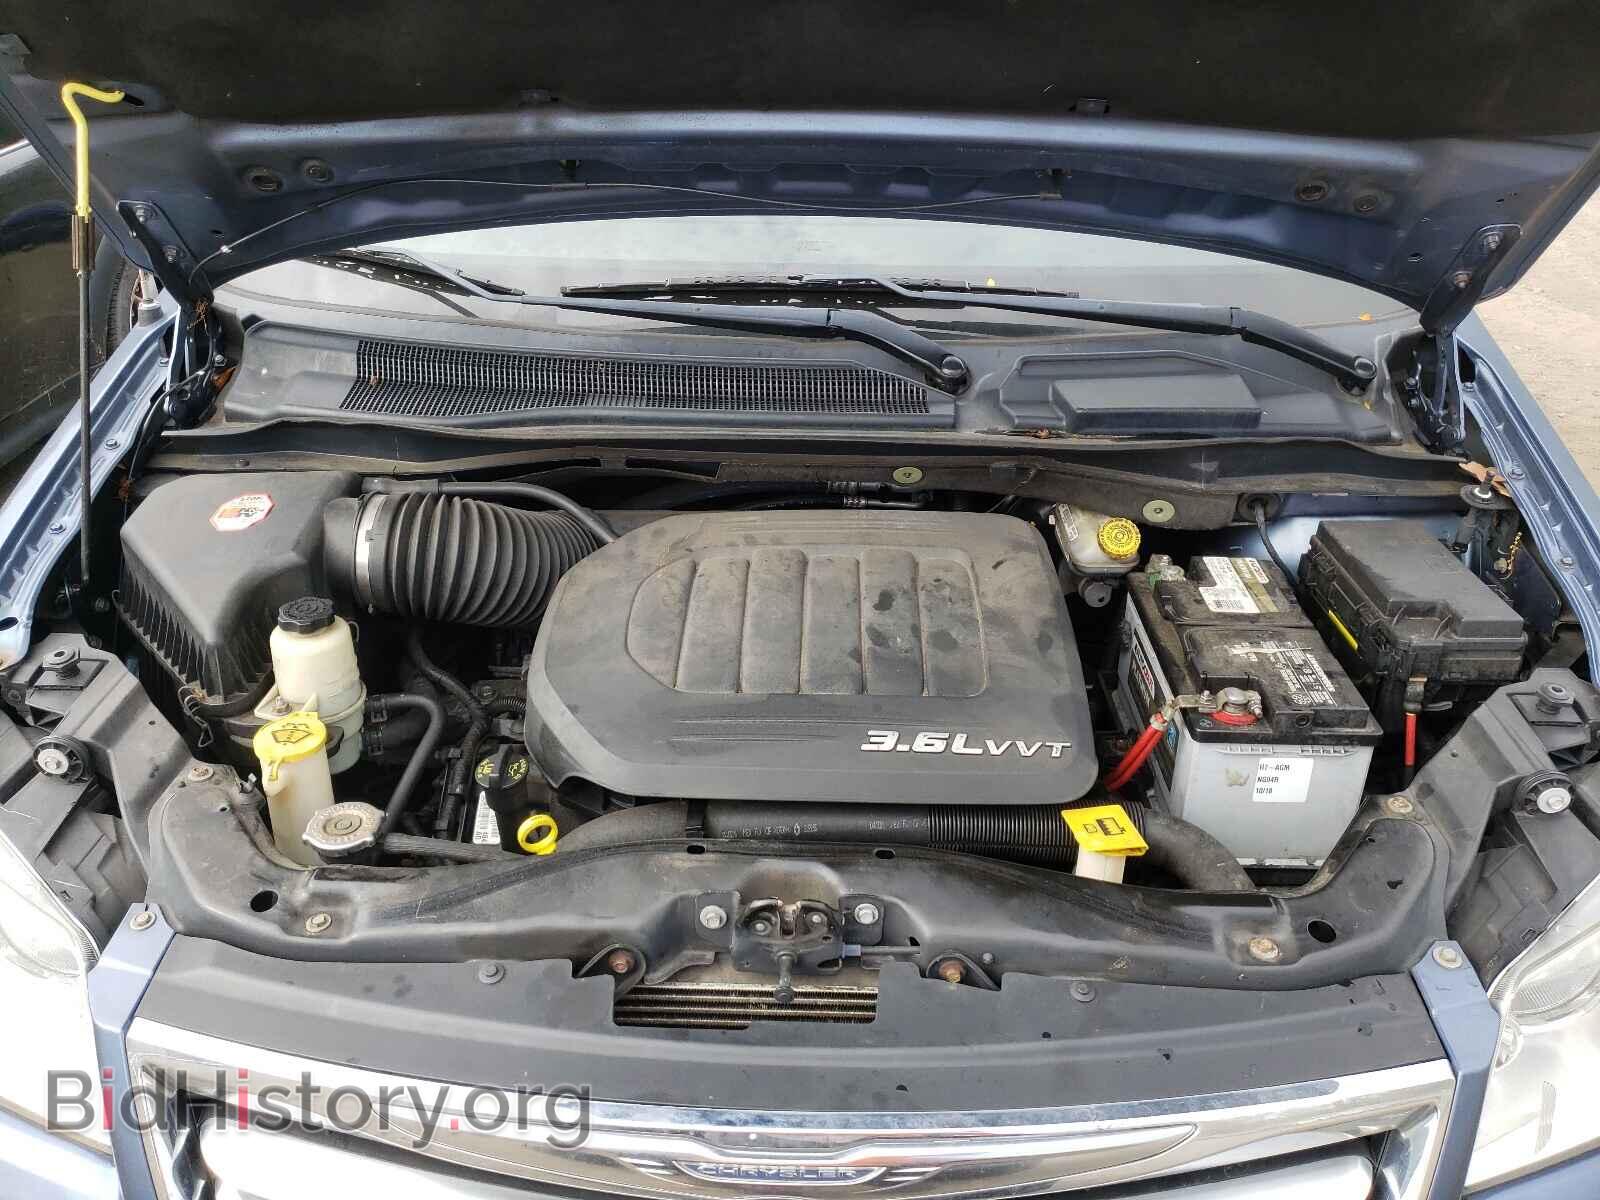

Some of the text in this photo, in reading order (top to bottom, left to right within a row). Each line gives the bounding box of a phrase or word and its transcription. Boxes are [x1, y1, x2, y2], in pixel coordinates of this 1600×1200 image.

[861, 730, 1071, 758] 3.6L VVT
[698, 1162, 858, 1179] CHRYSLER
